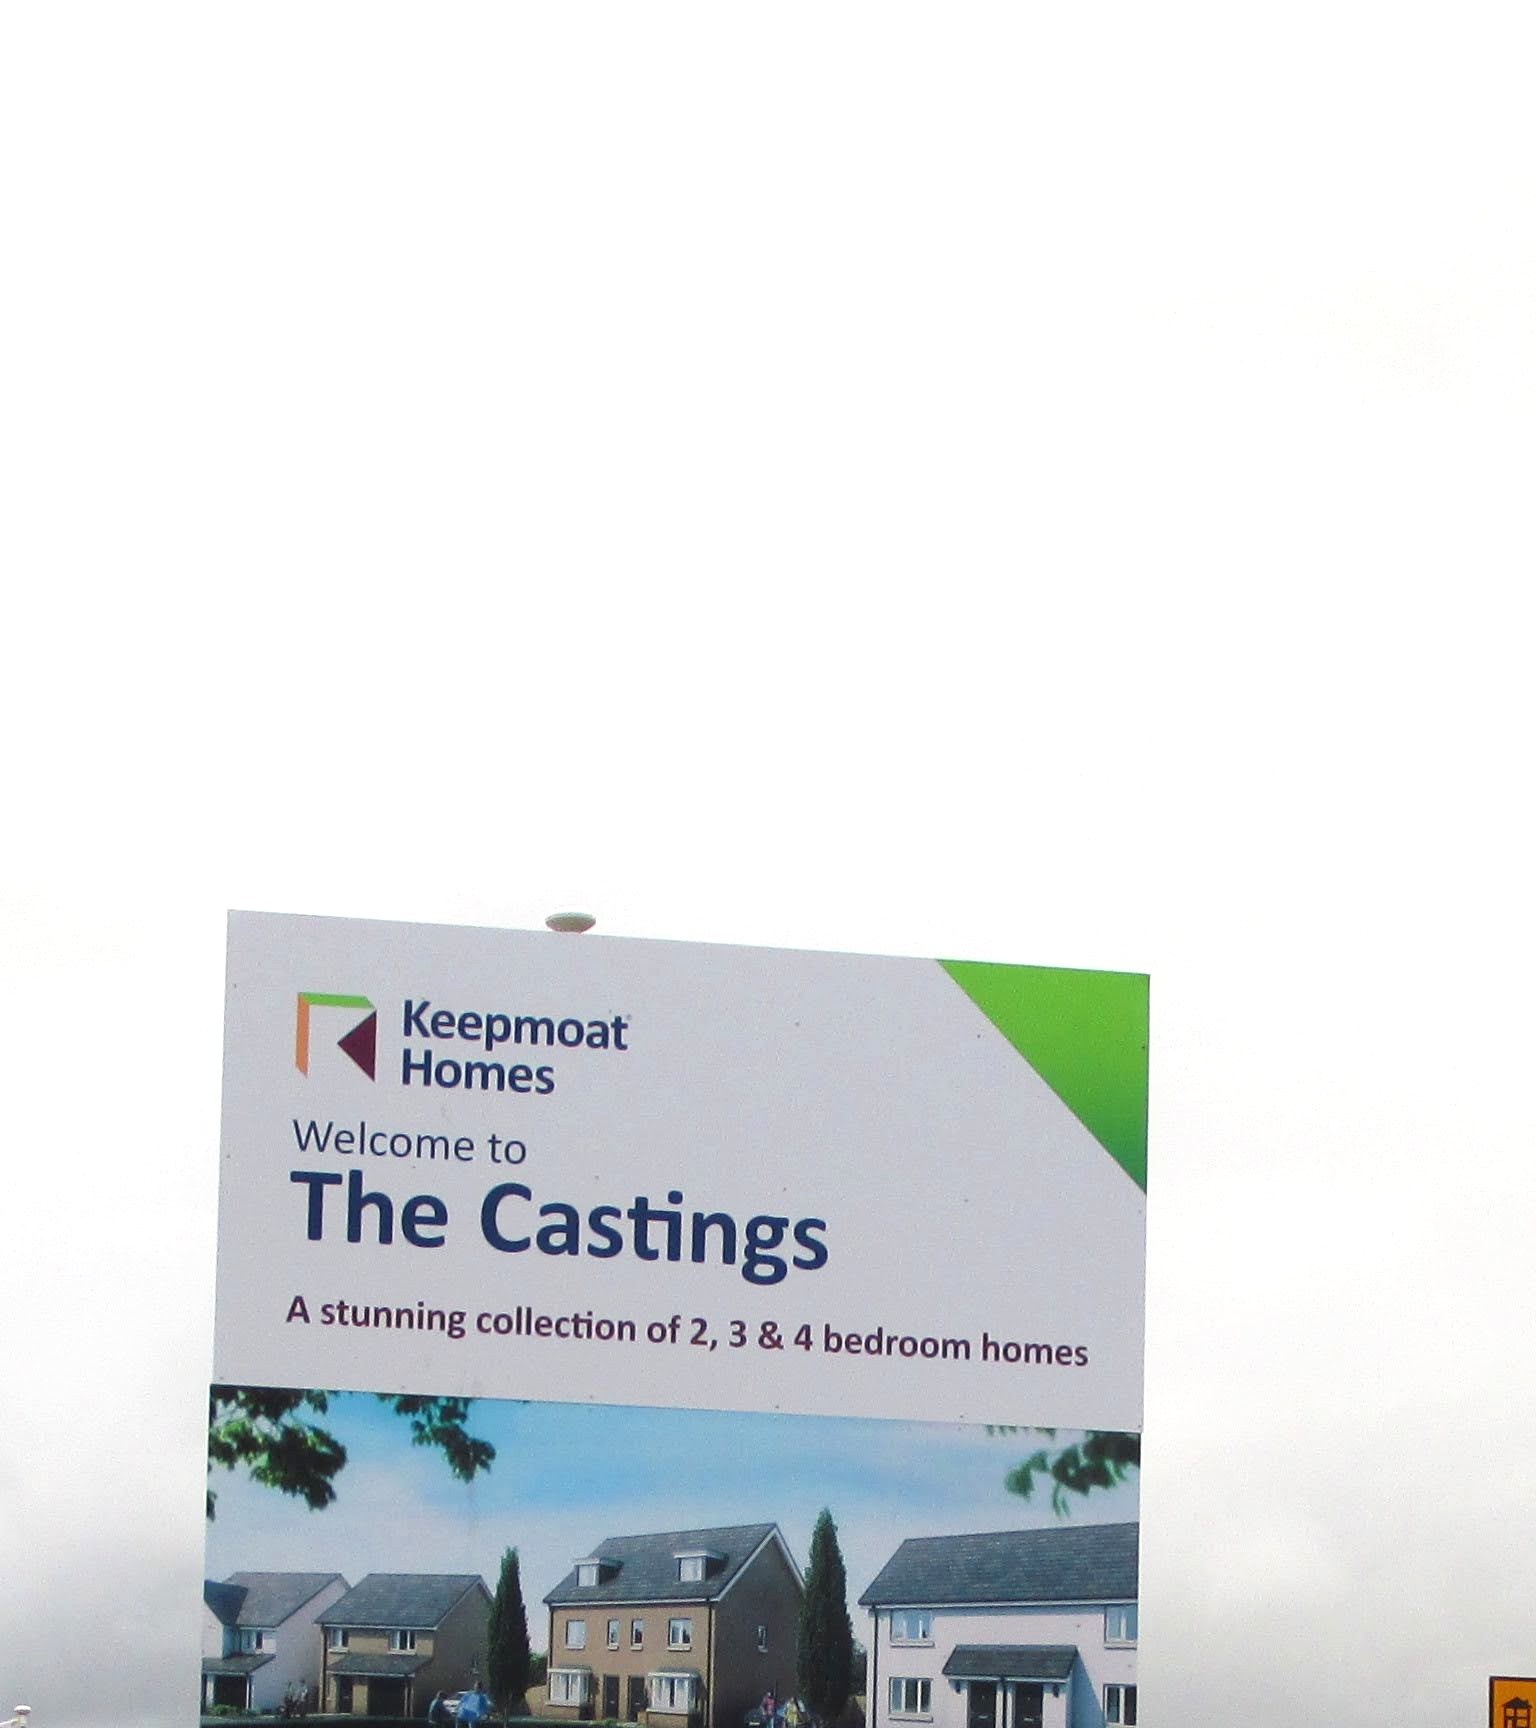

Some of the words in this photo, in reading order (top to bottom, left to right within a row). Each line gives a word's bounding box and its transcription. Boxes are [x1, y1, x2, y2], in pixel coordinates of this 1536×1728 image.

[403, 999, 629, 1053] Keepmoat
[402, 1047, 556, 1096] Homes
[293, 1117, 475, 1164] Welcome
[488, 1130, 528, 1165] to
[290, 1168, 449, 1249] The
[480, 1181, 830, 1286] Castings
[286, 1294, 312, 1326] A
[320, 1297, 467, 1338] stunning
[475, 1304, 638, 1343] collection
[646, 1312, 681, 1346] of
[690, 1317, 719, 1353] 2,
[729, 1318, 749, 1349] 3
[758, 1318, 785, 1350] &
[793, 1320, 815, 1352] 4
[823, 1323, 971, 1362] bedroom
[981, 1328, 1090, 1367] homes
